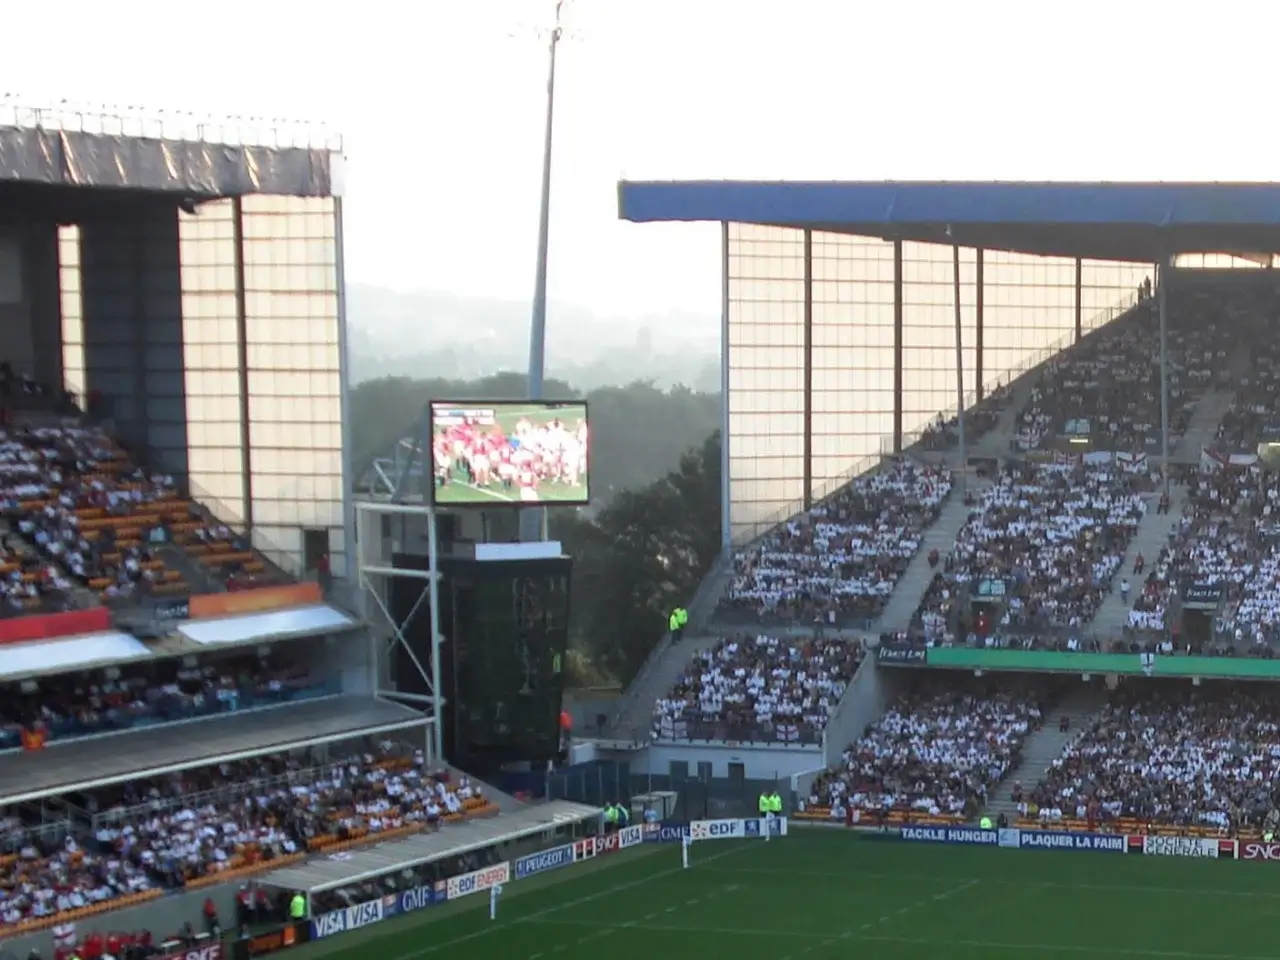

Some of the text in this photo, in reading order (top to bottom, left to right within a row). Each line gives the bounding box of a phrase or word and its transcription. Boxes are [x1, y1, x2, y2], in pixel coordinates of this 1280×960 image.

[620, 827, 640, 846] VISA
[901, 827, 997, 843] TACKLE HUNGER
[1022, 834, 1122, 849] PLAQUER LA FAIM
[525, 850, 564, 873] PEUGEOT
[402, 885, 429, 911] GMF
[314, 908, 344, 938] VISA
[350, 902, 379, 926] VISA
